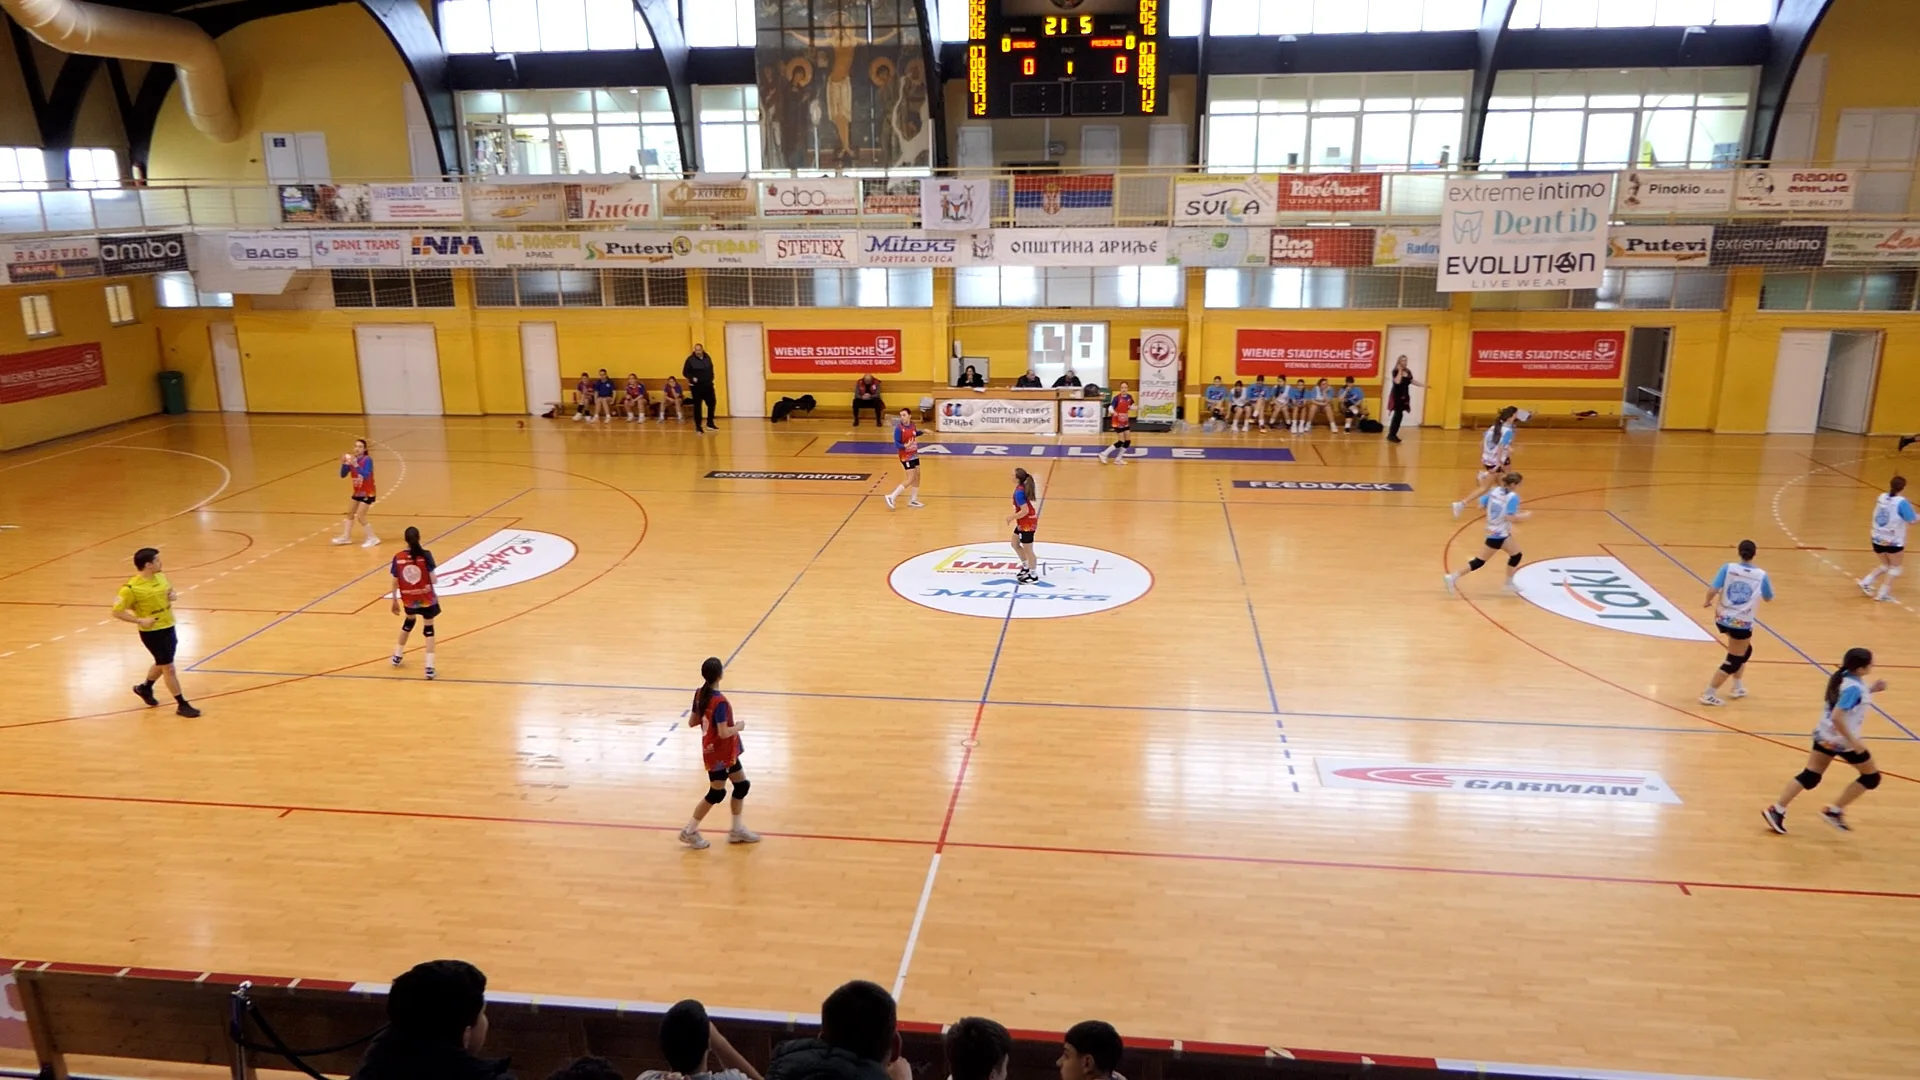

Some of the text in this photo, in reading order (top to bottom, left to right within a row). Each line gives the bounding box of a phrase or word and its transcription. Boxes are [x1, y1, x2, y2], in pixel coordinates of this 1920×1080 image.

[1001, 38, 1011, 52] 0
[1125, 35, 1136, 49] 0
[1024, 59, 1035, 75] 0
[1067, 61, 1073, 75] 1
[1115, 56, 1127, 73] 0
[1449, 182, 1606, 202] extreme intimo
[1649, 184, 1700, 195] Pinokio
[1492, 207, 1598, 236] Dentib
[365, 239, 400, 250] TRANS
[606, 242, 673, 254] Putevi
[777, 239, 846, 259] STETEX
[1010, 241, 1094, 254] ОПШТИНА
[1626, 238, 1707, 251] Putevi
[245, 248, 299, 259] BAGS
[1471, 278, 1568, 289] LIVE WEAR
[774, 346, 814, 356] WIENER
[1242, 348, 1285, 358] WIENER
[1478, 350, 1523, 359] WIENER
[1249, 481, 1394, 491] FEEDBACK
[1464, 779, 1639, 797] GARMAN
